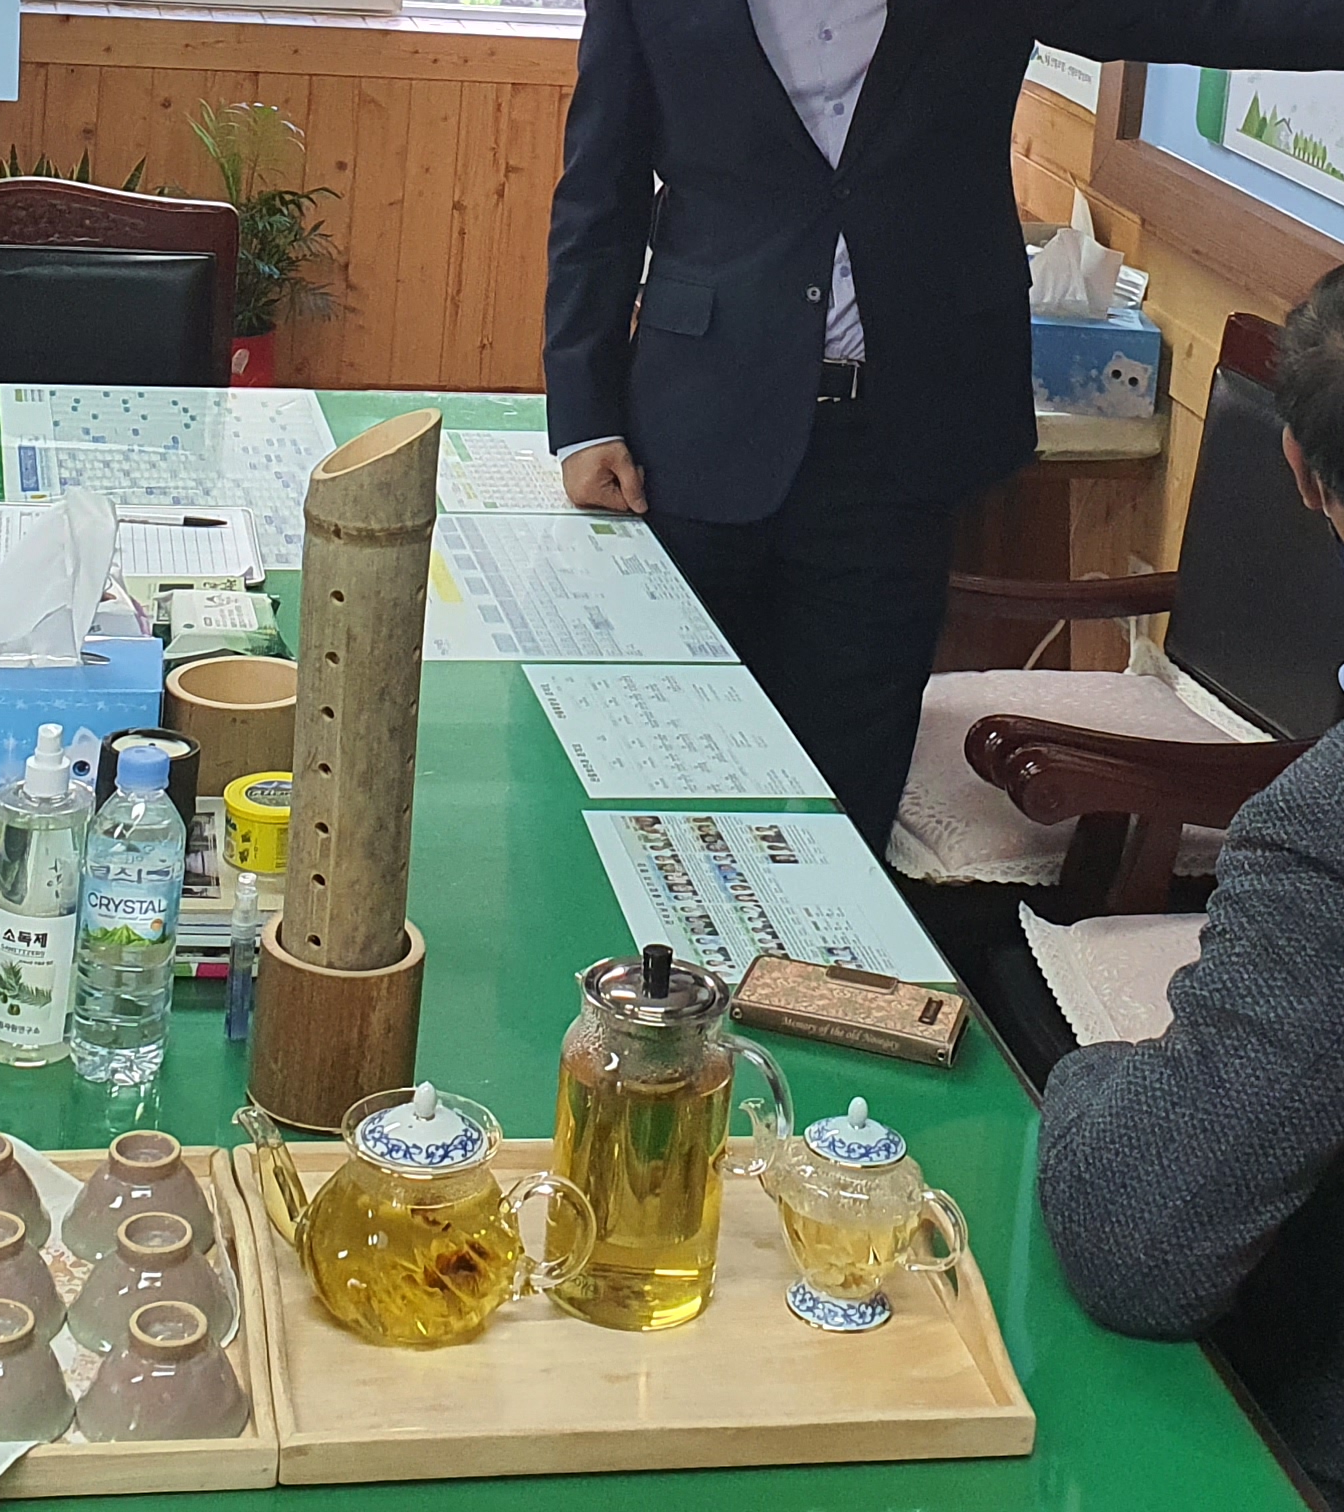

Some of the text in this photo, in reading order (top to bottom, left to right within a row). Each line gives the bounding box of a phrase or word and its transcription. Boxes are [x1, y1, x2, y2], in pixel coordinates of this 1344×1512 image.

[88, 892, 167, 915] CRYSTAL
[3, 928, 48, 948] 소독제
[782, 1016, 816, 1035] Memory
